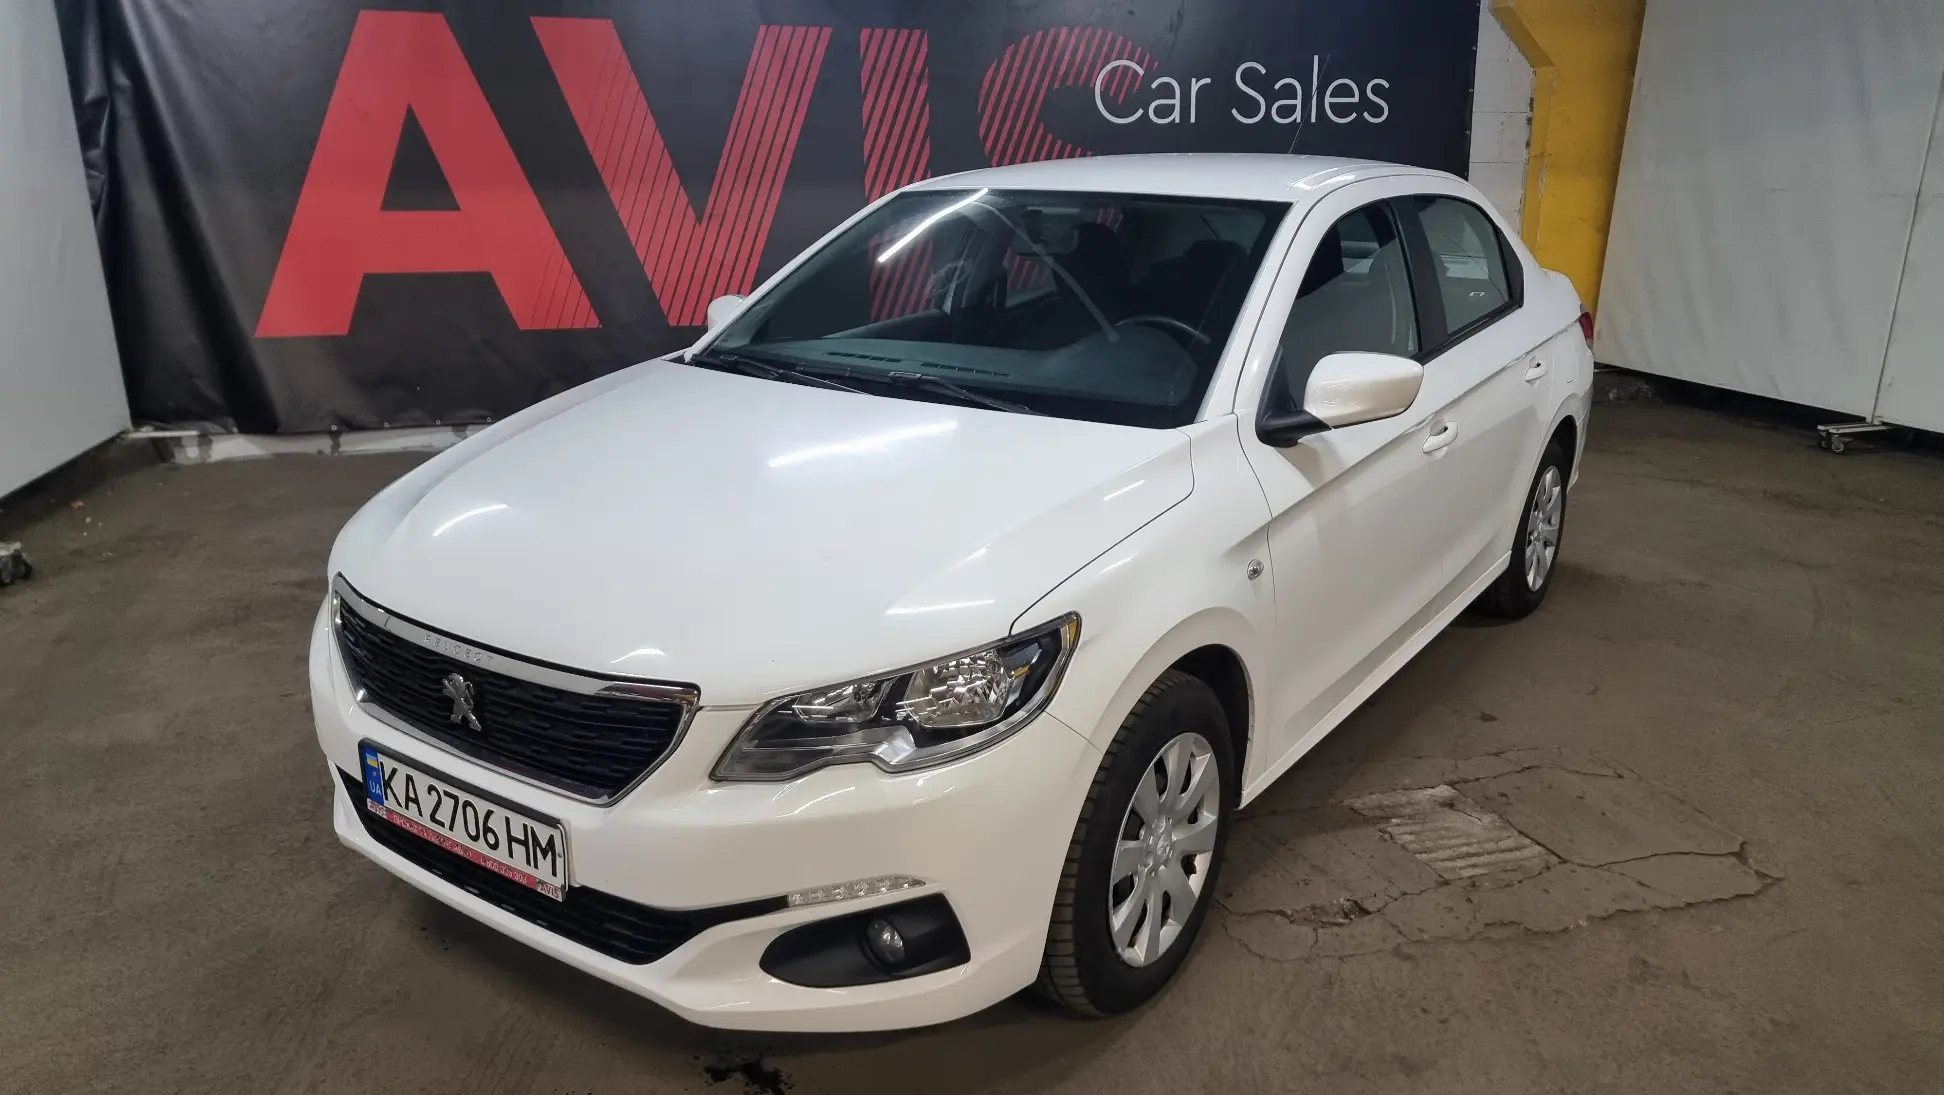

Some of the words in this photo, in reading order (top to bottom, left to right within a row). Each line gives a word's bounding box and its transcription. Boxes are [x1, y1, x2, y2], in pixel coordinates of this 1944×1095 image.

[1093, 58, 1211, 126] Car
[1230, 54, 1390, 125] Sales
[369, 781, 383, 799] UA
[380, 760, 424, 818] KA
[427, 783, 501, 852] 2706
[504, 815, 558, 879] HM
